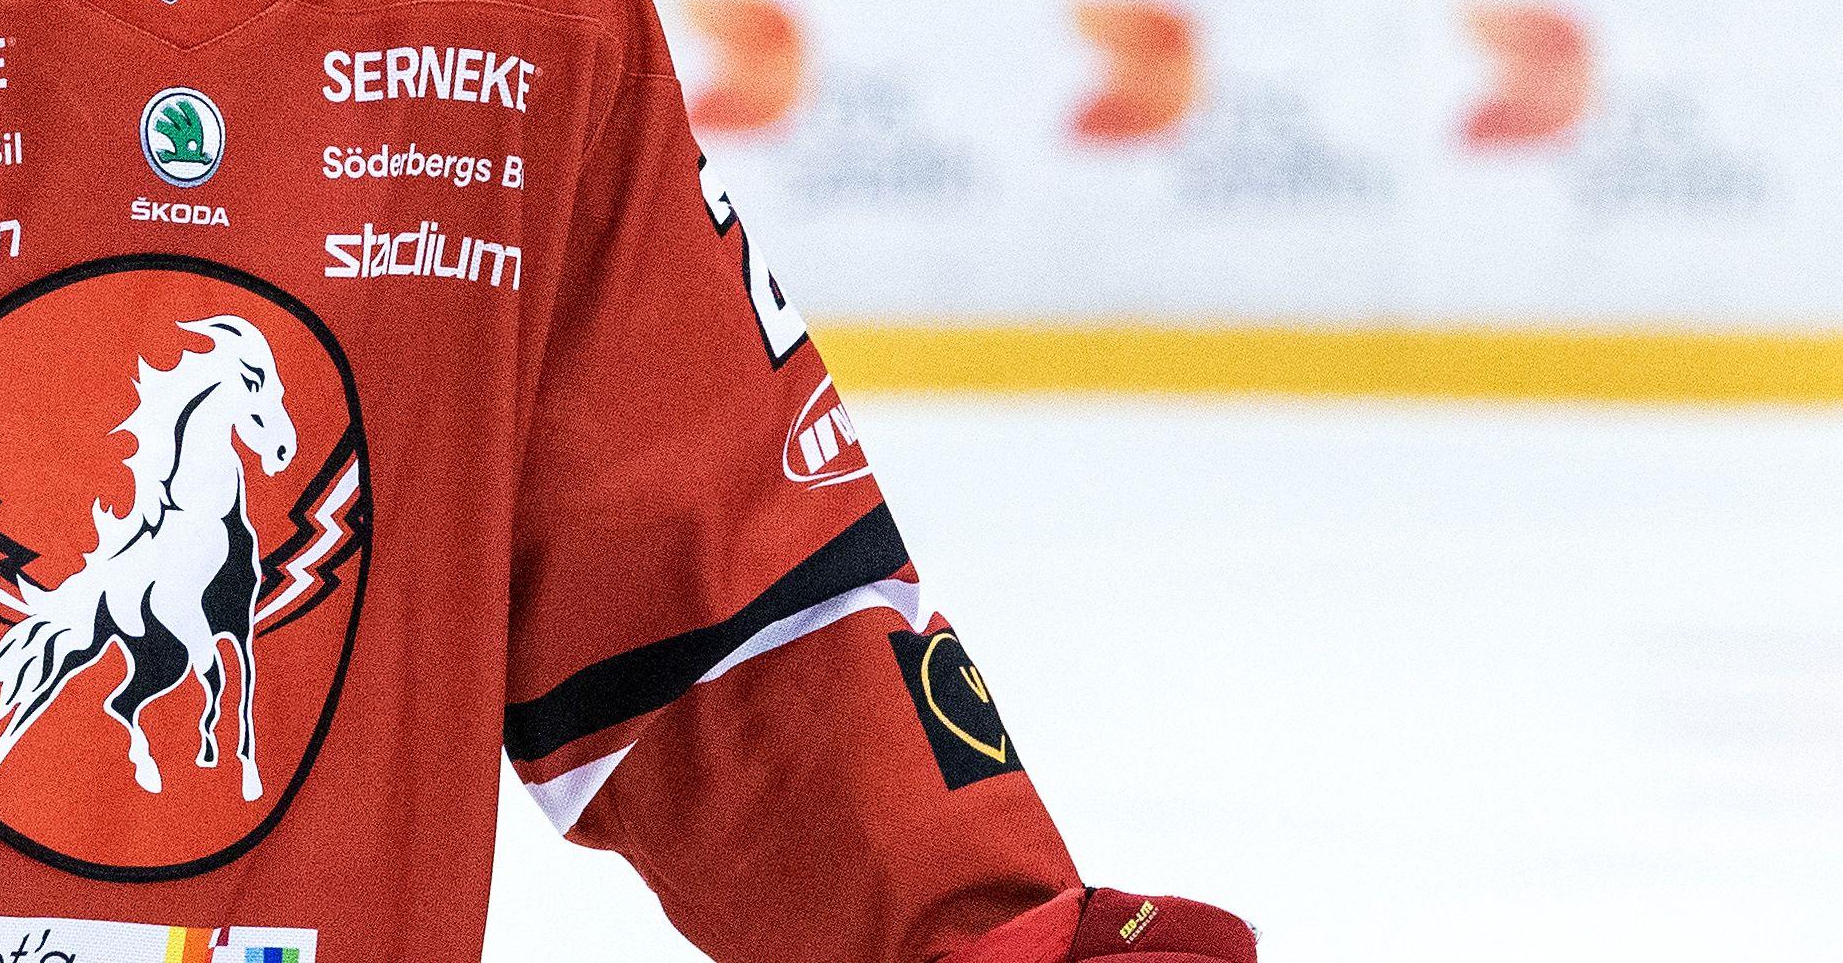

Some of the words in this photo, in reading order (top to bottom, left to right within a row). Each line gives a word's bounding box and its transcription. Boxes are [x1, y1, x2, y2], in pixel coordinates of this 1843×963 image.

[321, 45, 536, 114] SERNEKE
[321, 142, 493, 187] Söderbergs
[130, 196, 231, 228] ŠKODA
[323, 219, 523, 291] stadium
